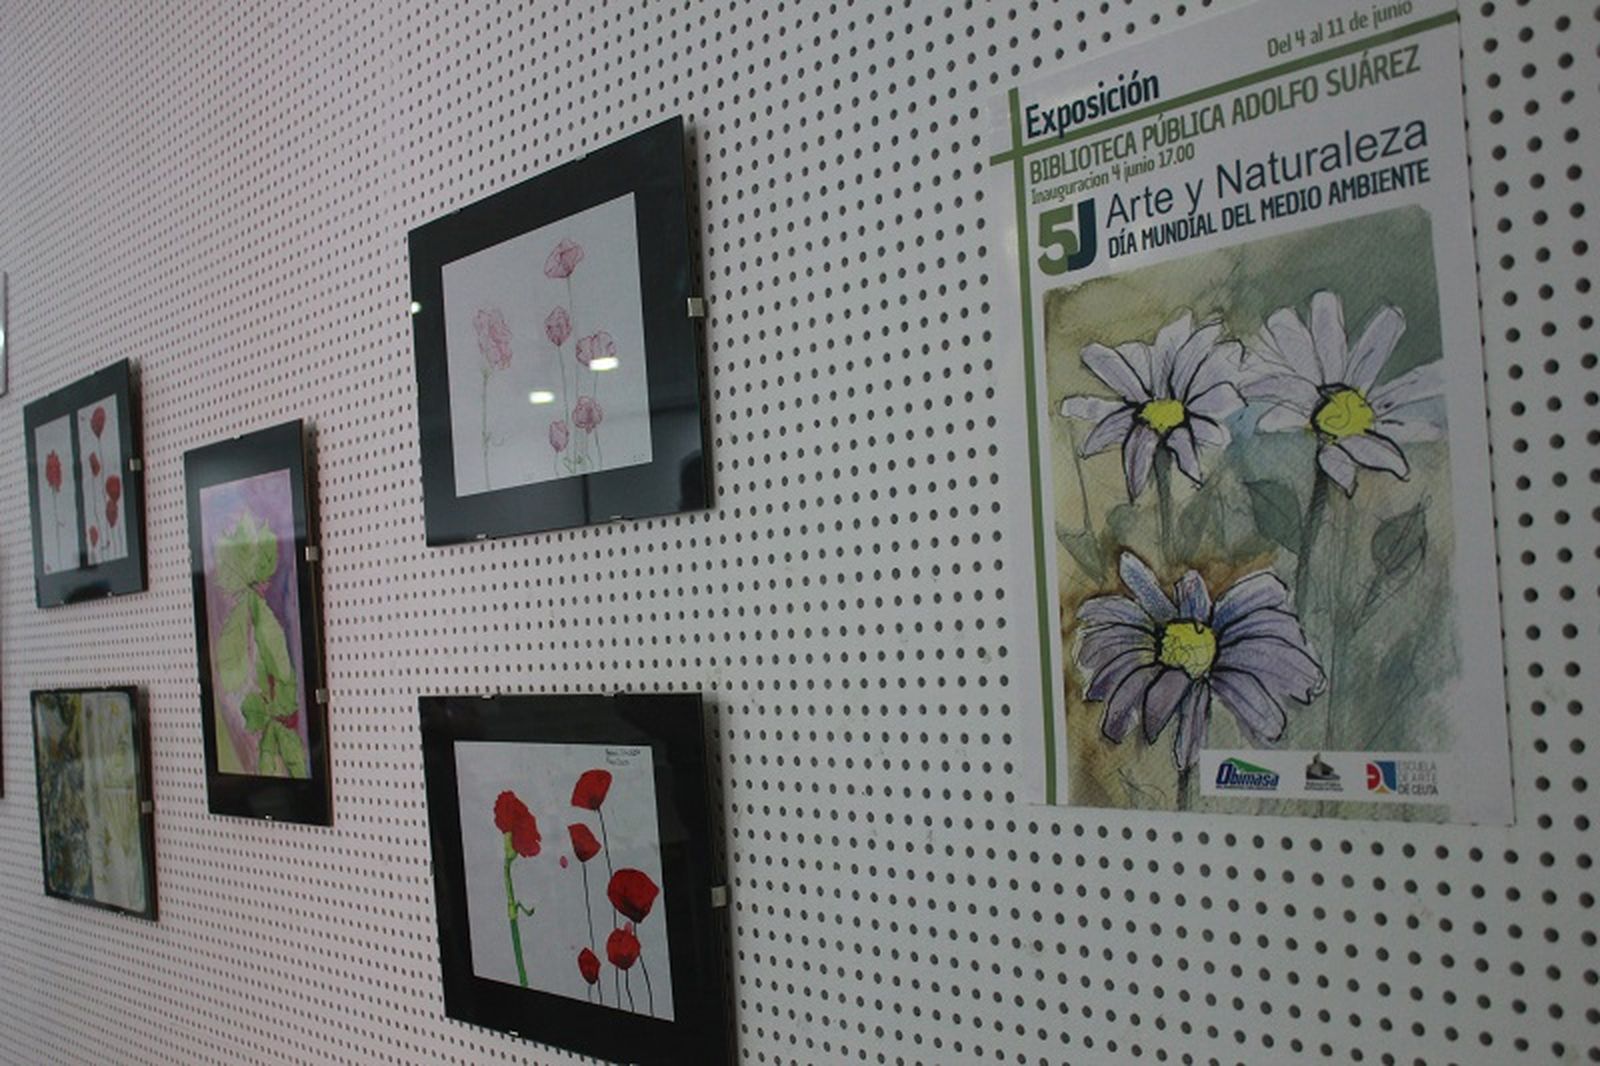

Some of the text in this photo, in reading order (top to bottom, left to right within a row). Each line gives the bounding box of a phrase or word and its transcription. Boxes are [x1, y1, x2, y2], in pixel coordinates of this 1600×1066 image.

[1267, 0, 1413, 58] Del 4 al 11 de junio
[1025, 69, 1160, 139] Exposición
[1030, 43, 1421, 185] BIBLIOTECA PÚBLICA ADOLFO SUÁREZ
[1031, 143, 1195, 205] Inauguracion 4 junio 17.00
[1106, 119, 1428, 228] Arte y Naturaleza
[1108, 158, 1431, 259] DÍA MUNDIAL DEL MEDIO AMBIENTE
[1038, 197, 1098, 276] 5J
